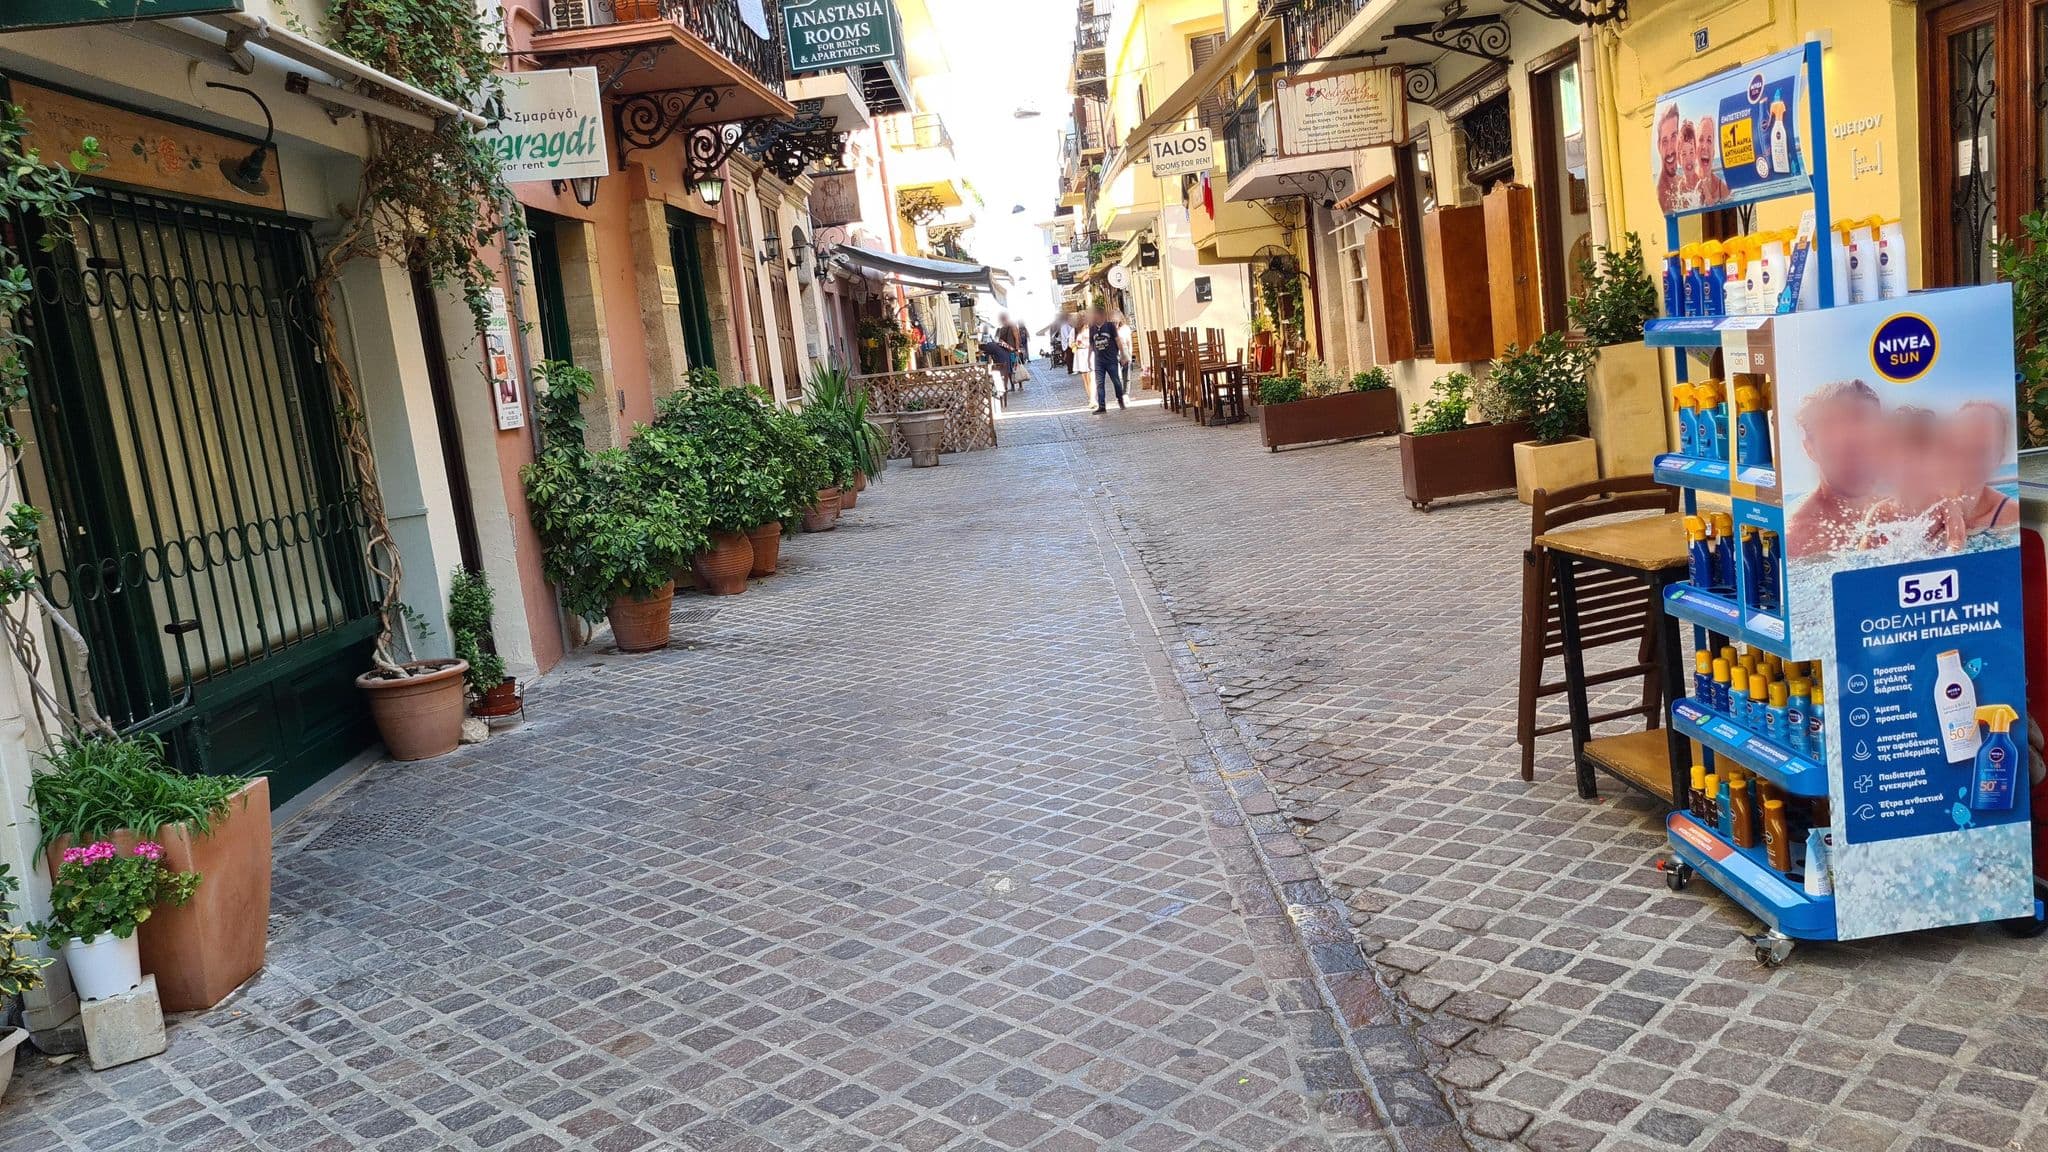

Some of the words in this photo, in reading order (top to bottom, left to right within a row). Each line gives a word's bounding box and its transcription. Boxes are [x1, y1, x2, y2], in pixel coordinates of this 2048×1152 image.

[792, 0, 883, 28] ANASTASIA
[804, 22, 870, 45] ROOMS
[817, 42, 834, 52] FOR
[836, 38, 860, 49] RENT
[800, 55, 808, 63] &
[811, 43, 880, 62] APARTMENTS
[514, 107, 577, 124] Σμαράγδι
[1153, 136, 1207, 158] TALOS
[522, 160, 545, 170] rent
[1156, 161, 1180, 171] ROOMS
[1181, 159, 1194, 167] FOR
[1195, 157, 1210, 165] RENT
[1879, 334, 1931, 354] NIVEA
[1754, 353, 1765, 366] BB
[1890, 351, 1919, 366] SUN
[1861, 611, 1926, 633] ΟΦΕΛΗ
[1931, 608, 1958, 623] ΓΙΑ
[1962, 601, 1999, 619] ΤΗΝ
[1863, 630, 1918, 648] ΠΑΙΔΙΚΗ
[1921, 619, 2002, 640] ΕΠΙΔΕΡΜΙΔΑ
[1873, 663, 1916, 676] Προστασία
[1874, 674, 1908, 687] μεγάλης
[1874, 684, 1913, 695] διάρκειας
[1874, 704, 1900, 714] Άμεση
[1875, 711, 1918, 725] προστασία
[1876, 731, 1918, 743] Αποτρέπει
[1877, 744, 1891, 753] την
[1892, 738, 1939, 750] αφυδάτωση
[1877, 753, 1892, 762] της
[1892, 746, 1940, 759] επιδερμίδας
[1879, 768, 1926, 781] Παιδιατρικά
[1878, 799, 1903, 810] Έξτρα
[1904, 793, 1944, 805] ανθεκτικό
[1896, 807, 1915, 817] νερό
